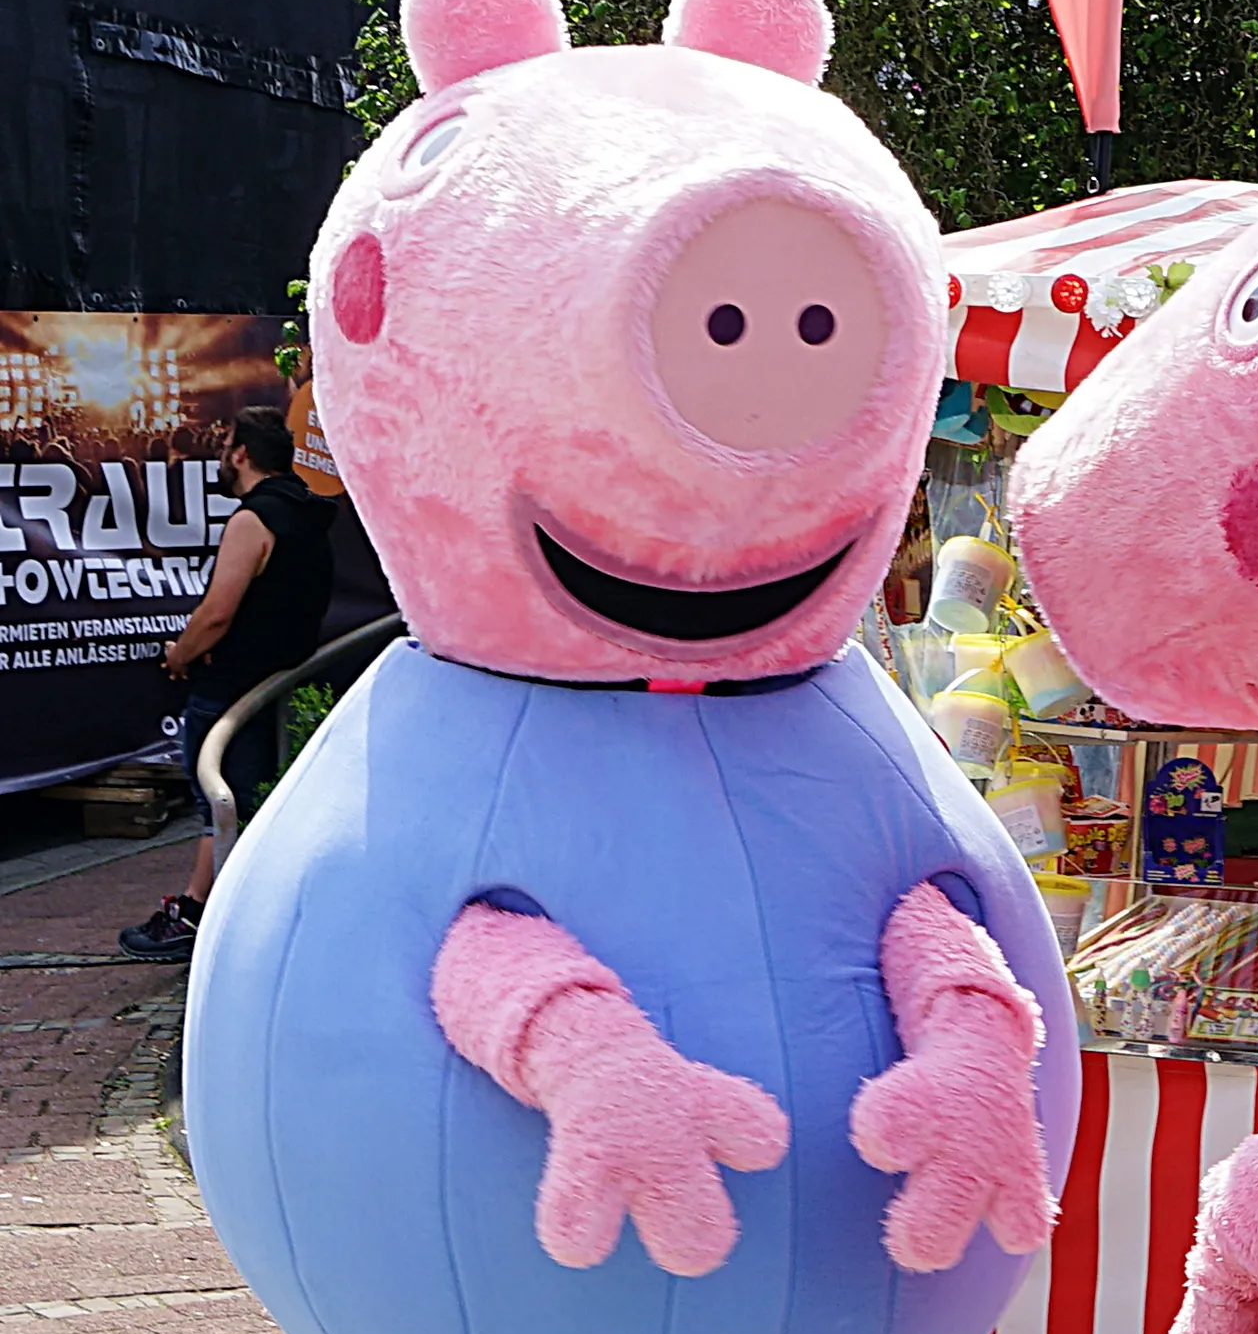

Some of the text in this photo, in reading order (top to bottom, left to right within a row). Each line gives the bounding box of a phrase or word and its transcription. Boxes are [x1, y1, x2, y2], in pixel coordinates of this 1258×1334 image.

[294, 447, 341, 478] ELEME
[13, 648, 53, 670] ALLE
[55, 642, 127, 667] ANLÄSSE
[129, 641, 162, 662] UND
